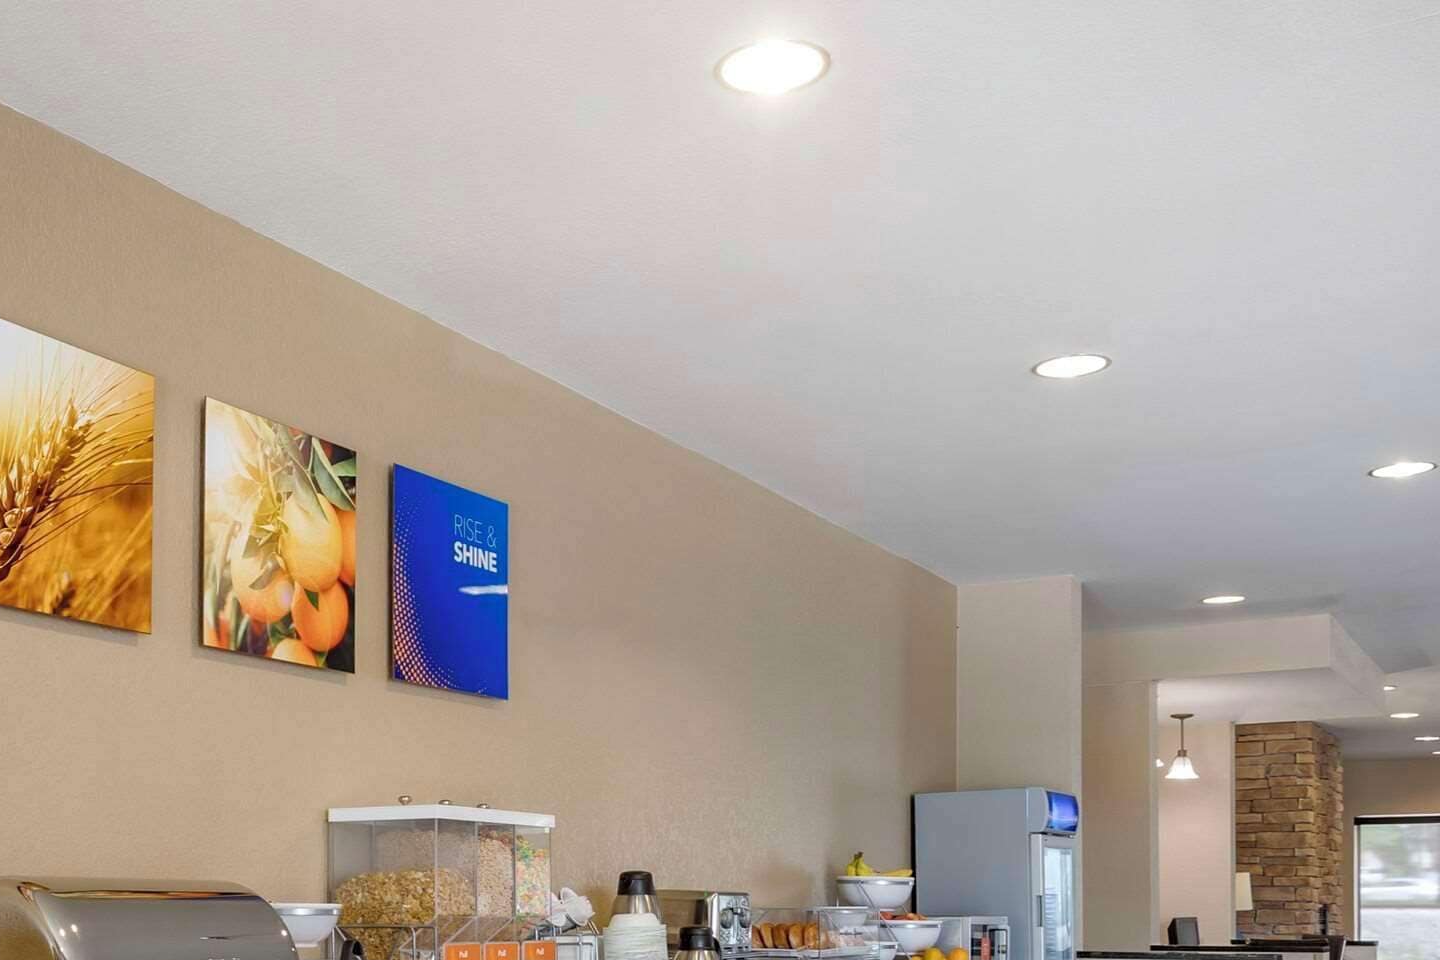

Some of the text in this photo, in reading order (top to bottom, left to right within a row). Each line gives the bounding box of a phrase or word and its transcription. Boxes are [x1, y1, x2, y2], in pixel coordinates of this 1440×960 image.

[454, 514, 497, 549] RISE &
[453, 541, 498, 573] SHINE
